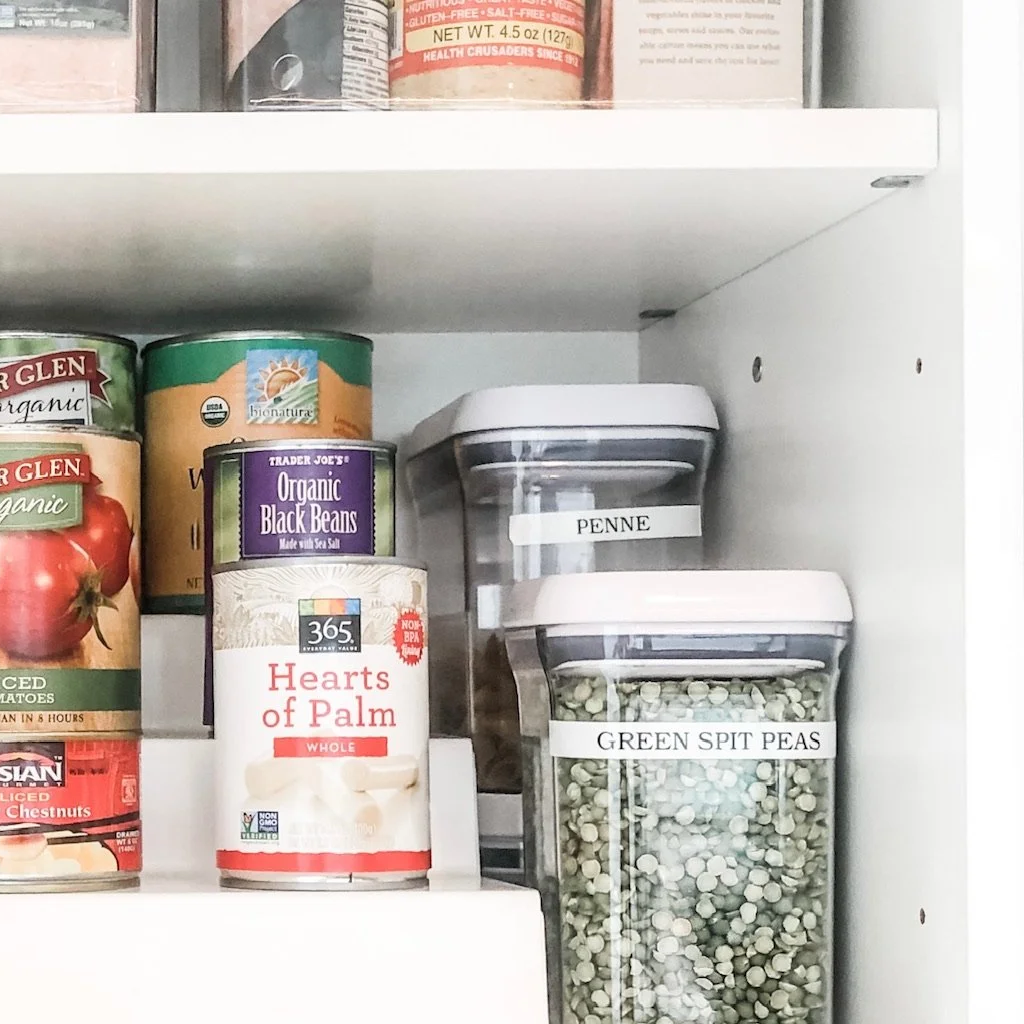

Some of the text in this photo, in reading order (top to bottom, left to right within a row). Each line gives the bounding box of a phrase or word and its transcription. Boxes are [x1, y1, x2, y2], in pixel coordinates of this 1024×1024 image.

[488, 8, 545, 18] SALT-FREE
[433, 28, 459, 44] NET
[468, 25, 494, 39] WT.
[500, 24, 520, 38] 4.5
[524, 28, 539, 40] oz
[423, 45, 563, 63] HEALTH CRUSADERS SINCE
[15, 356, 86, 385] GLEN
[269, 456, 311, 466] TRADER
[14, 458, 82, 484] GLEN
[278, 471, 342, 506] Organic
[260, 504, 357, 535] Black Beans
[577, 516, 651, 535] PENNE
[280, 538, 340, 549] Made with Sea Salt
[308, 617, 352, 645] 365
[404, 631, 420, 642] BPA
[268, 663, 390, 691] Hearts
[22, 714, 34, 723] IN
[48, 714, 84, 723] HOURS
[262, 696, 396, 728] of Palm
[308, 742, 356, 753] WHOLE
[598, 731, 821, 751] GREEN SPIT PEAS
[6, 804, 91, 818] Chestnuts
